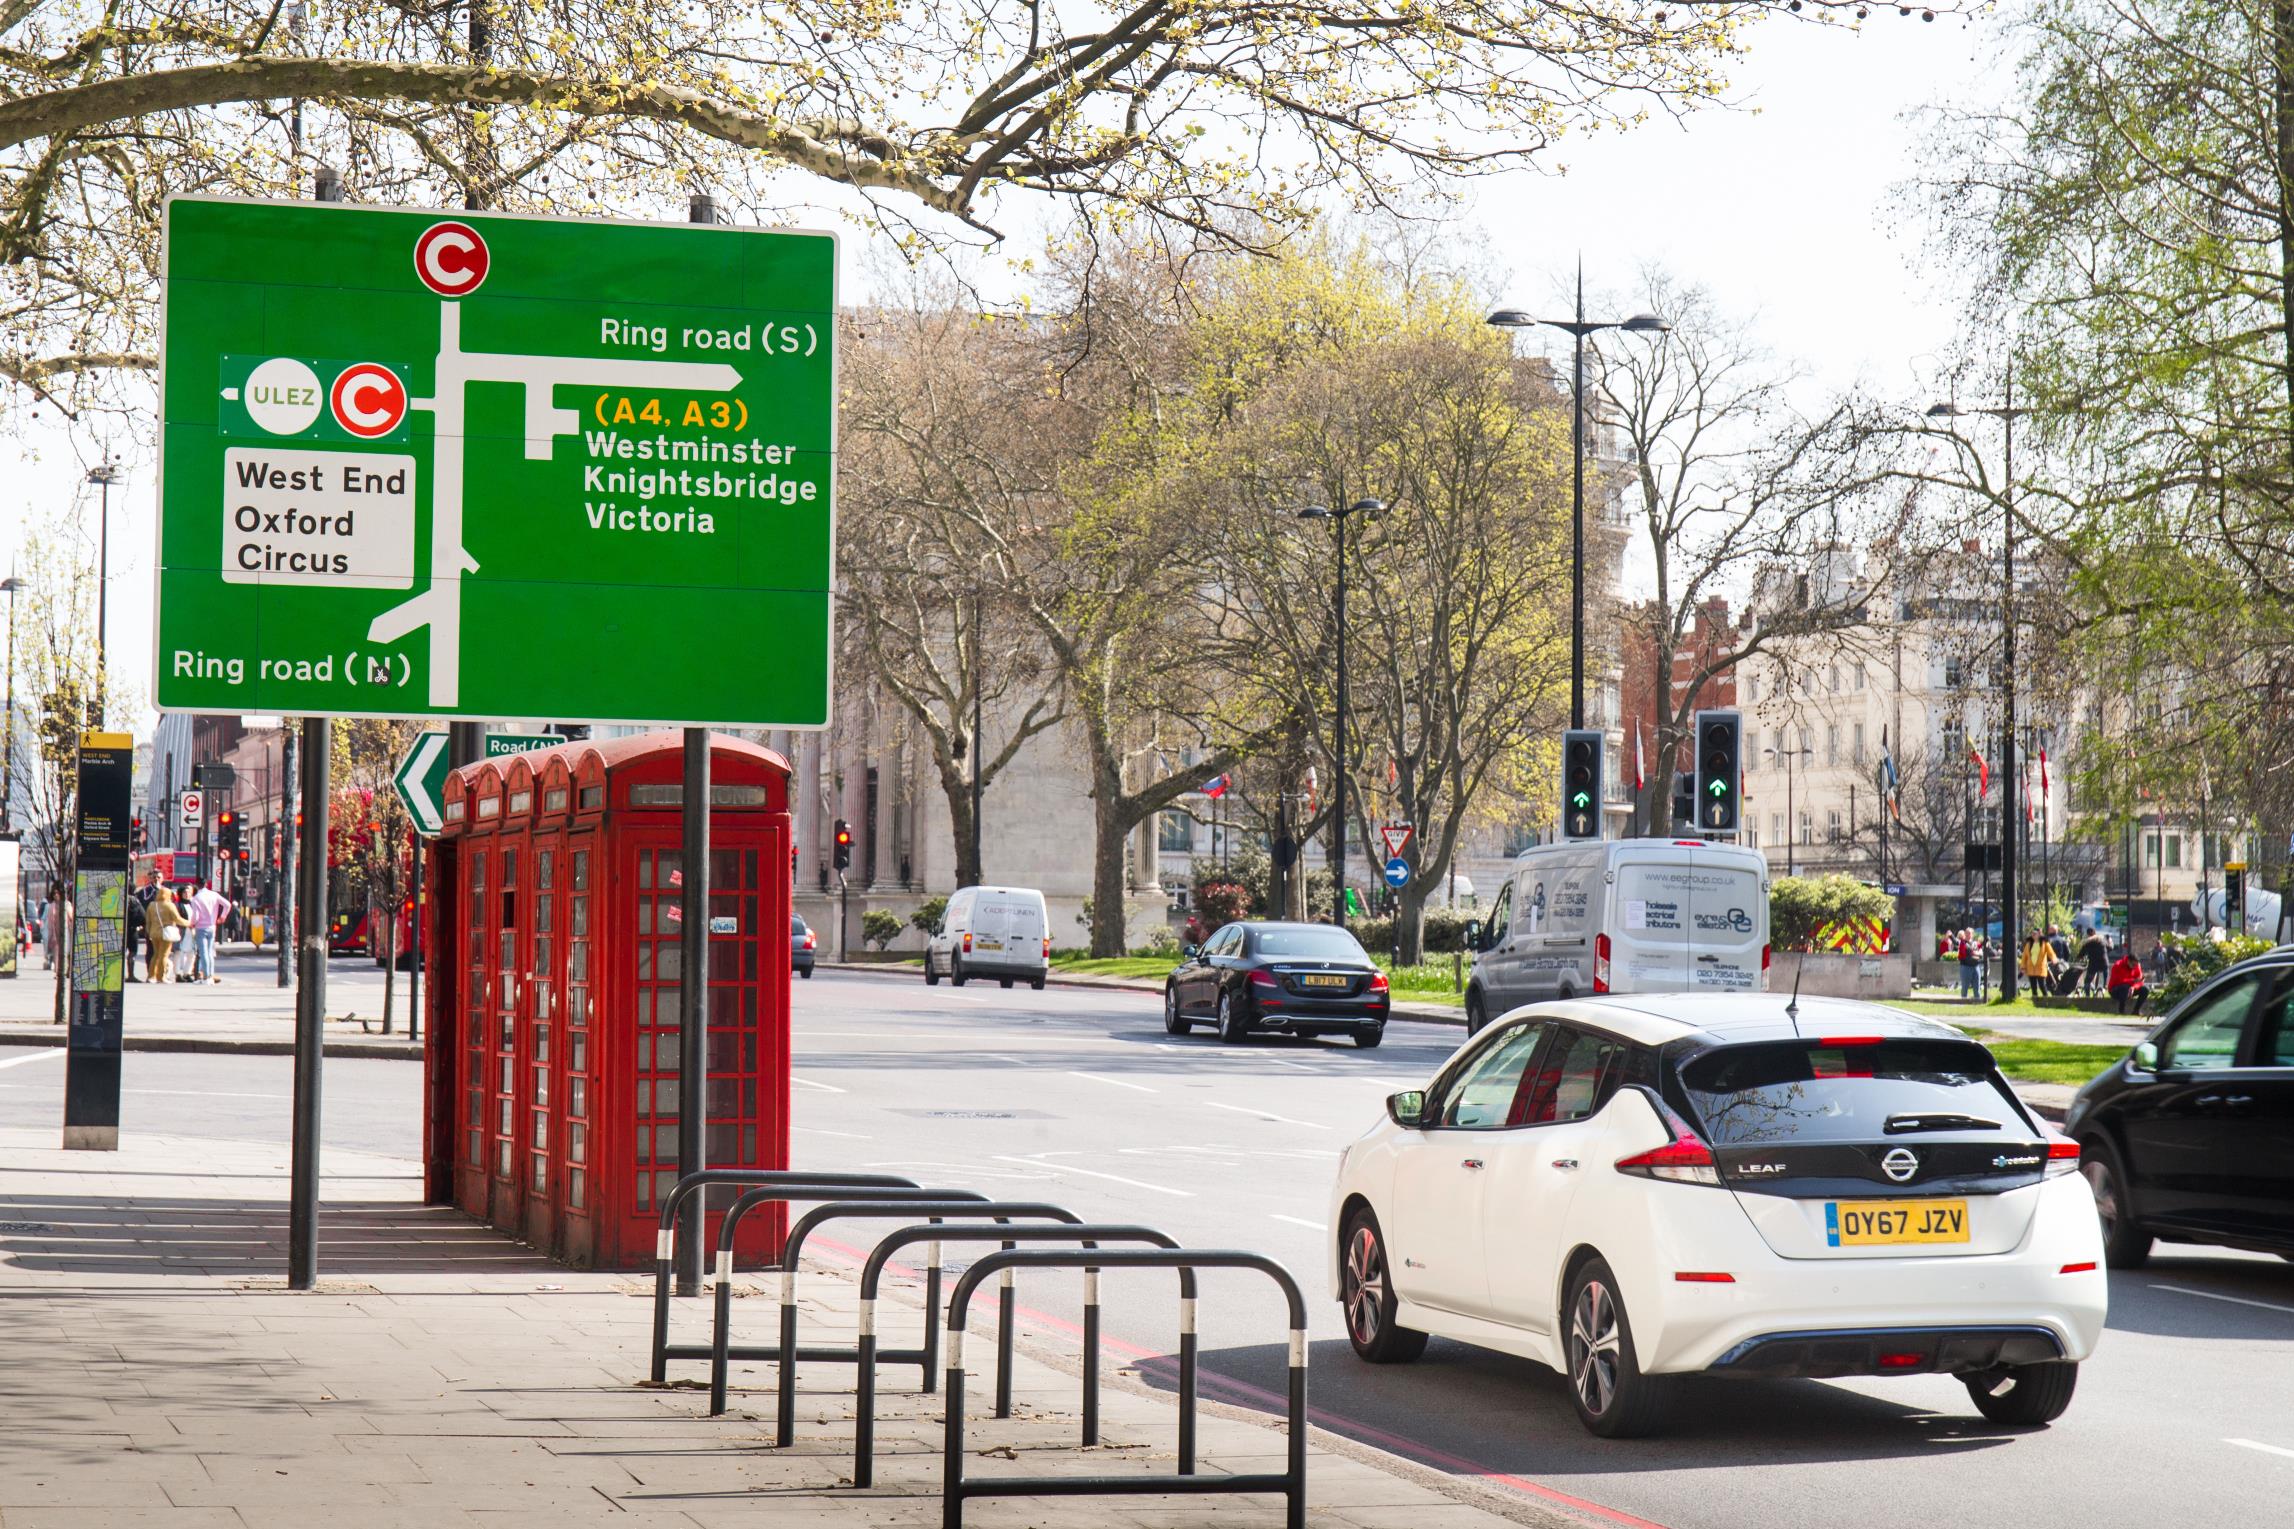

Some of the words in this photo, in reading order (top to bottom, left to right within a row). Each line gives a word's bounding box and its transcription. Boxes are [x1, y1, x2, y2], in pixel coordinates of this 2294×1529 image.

[601, 318, 667, 353] Ring
[683, 324, 751, 351] road
[761, 322, 817, 357] (S)
[254, 386, 315, 406] ULEZ
[595, 393, 671, 427] (A4,
[682, 399, 748, 432] A3)
[585, 430, 797, 465] Westminster
[236, 461, 323, 492] West
[343, 466, 405, 495] End
[584, 465, 817, 506] Knightsbridge
[235, 505, 354, 537] Oxford
[585, 502, 715, 534] Victoria
[238, 543, 348, 574] Circus
[174, 650, 244, 685] Ring
[260, 654, 333, 682] road
[344, 651, 411, 688] (N)
[490, 740, 526, 753] Road
[1644, 873, 1736, 885] www.eegroup.co.uk
[1646, 911, 1675, 919] ectrical
[1646, 920, 1681, 928] tributors
[1738, 1163, 1787, 1174] LEAF
[1845, 1210, 1908, 1236] OY67
[1918, 1209, 1962, 1234] JZV
